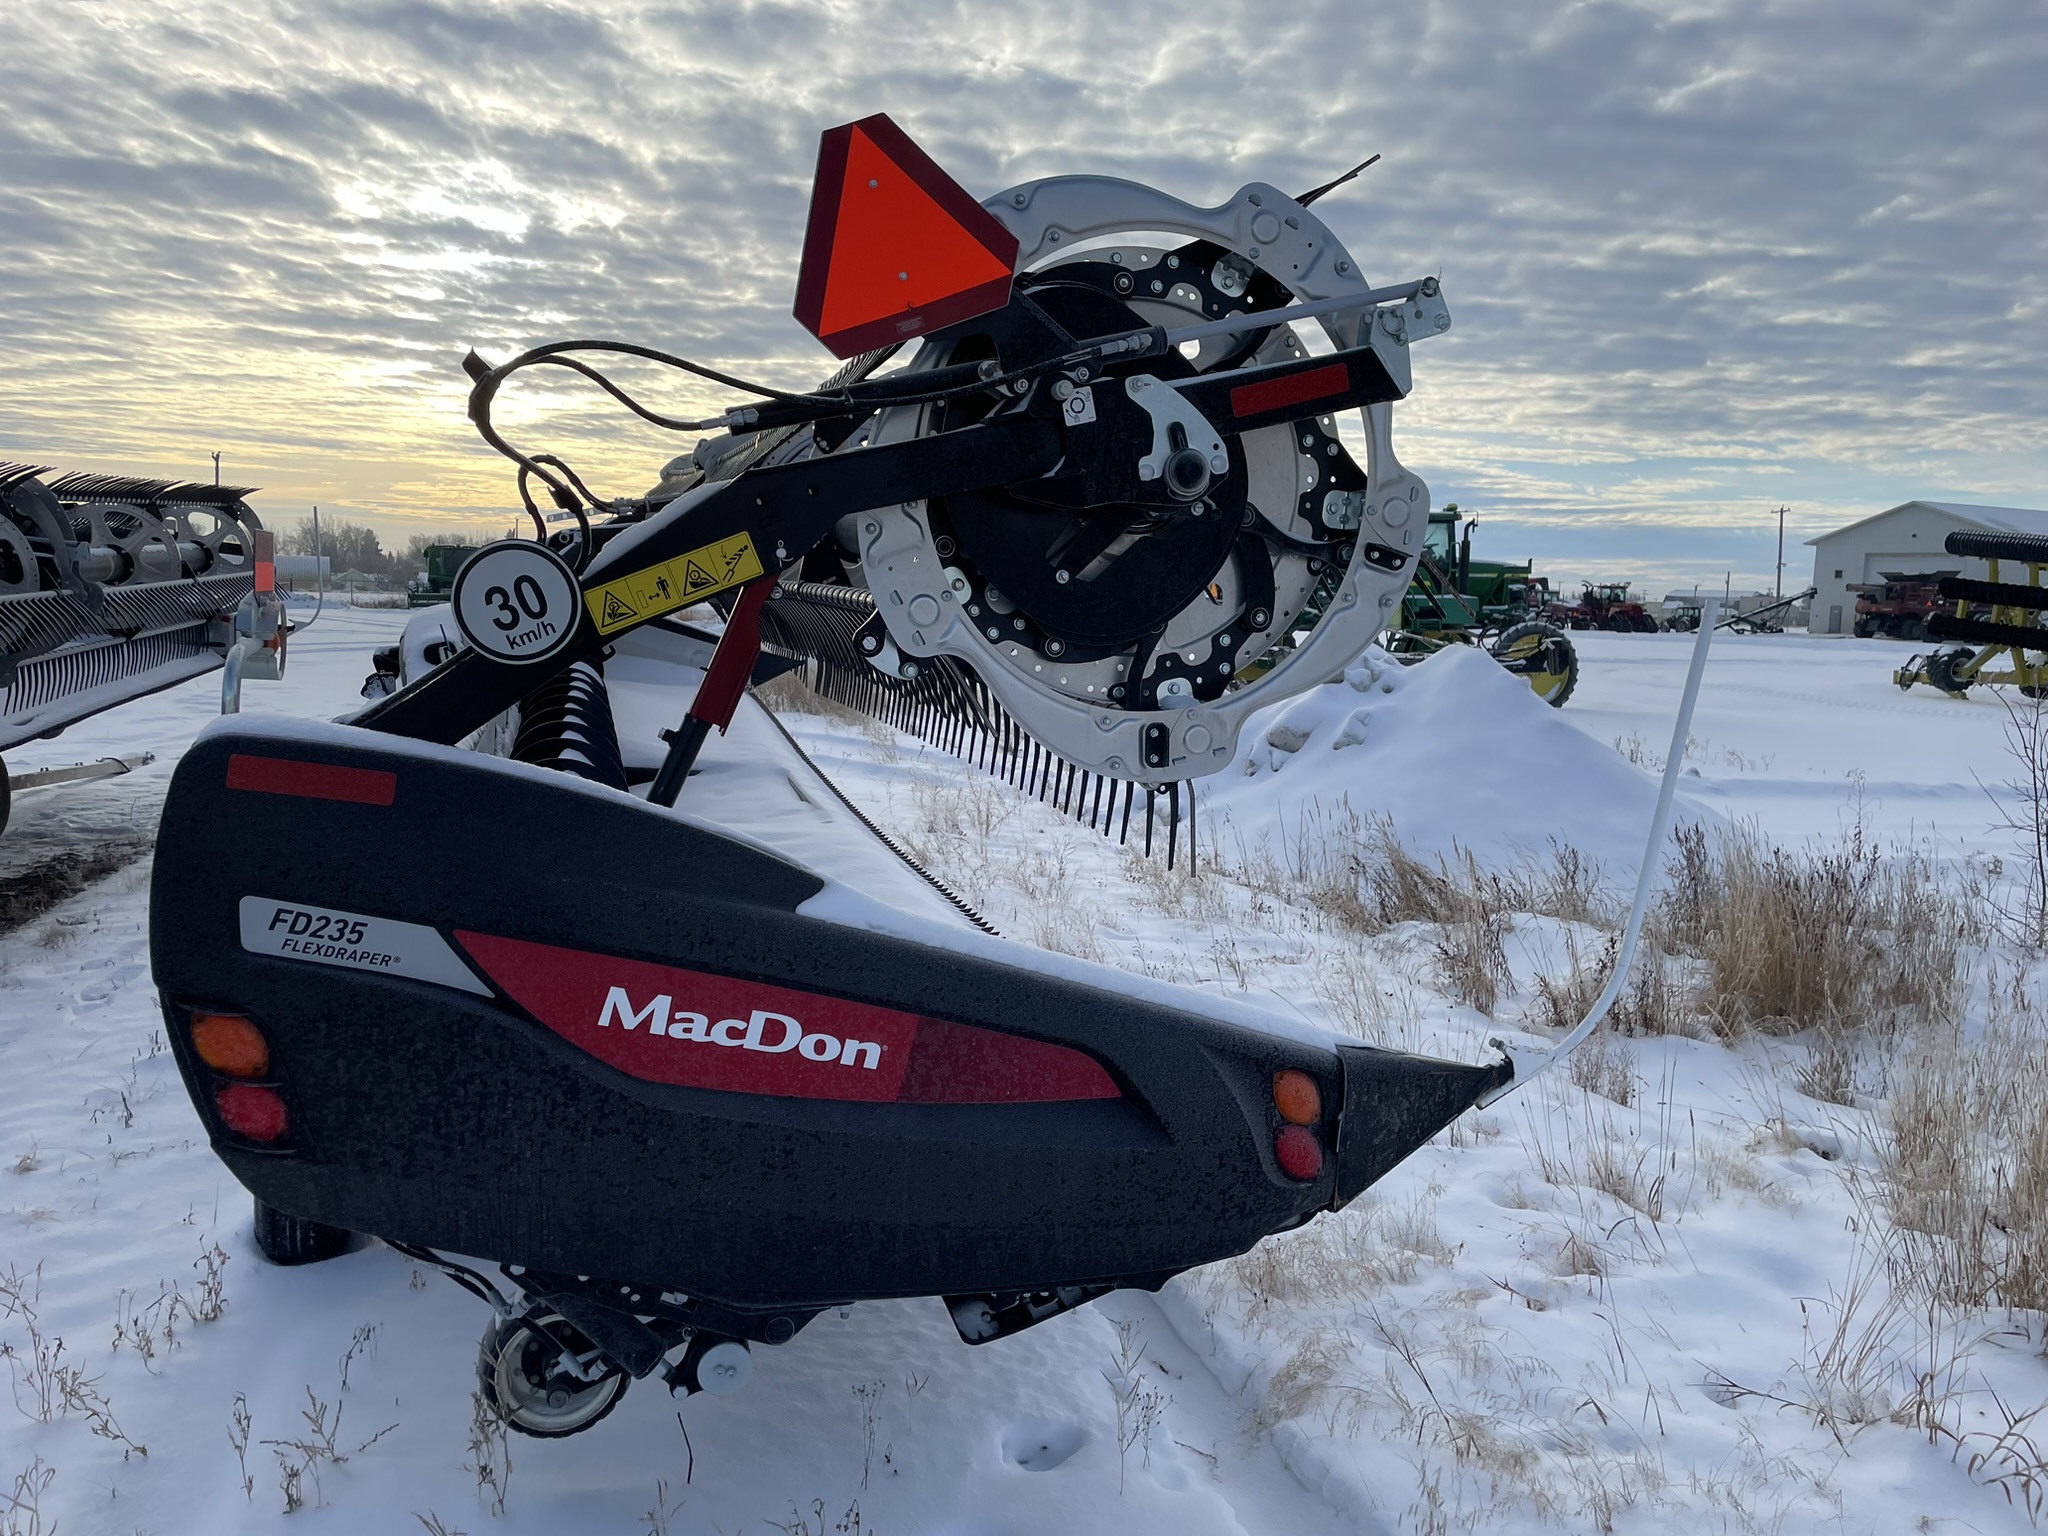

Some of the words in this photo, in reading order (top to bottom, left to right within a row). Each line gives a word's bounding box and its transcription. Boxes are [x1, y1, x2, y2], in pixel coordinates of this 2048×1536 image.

[484, 574, 548, 631] 30
[505, 620, 557, 650] km/h
[267, 907, 369, 945] FD235
